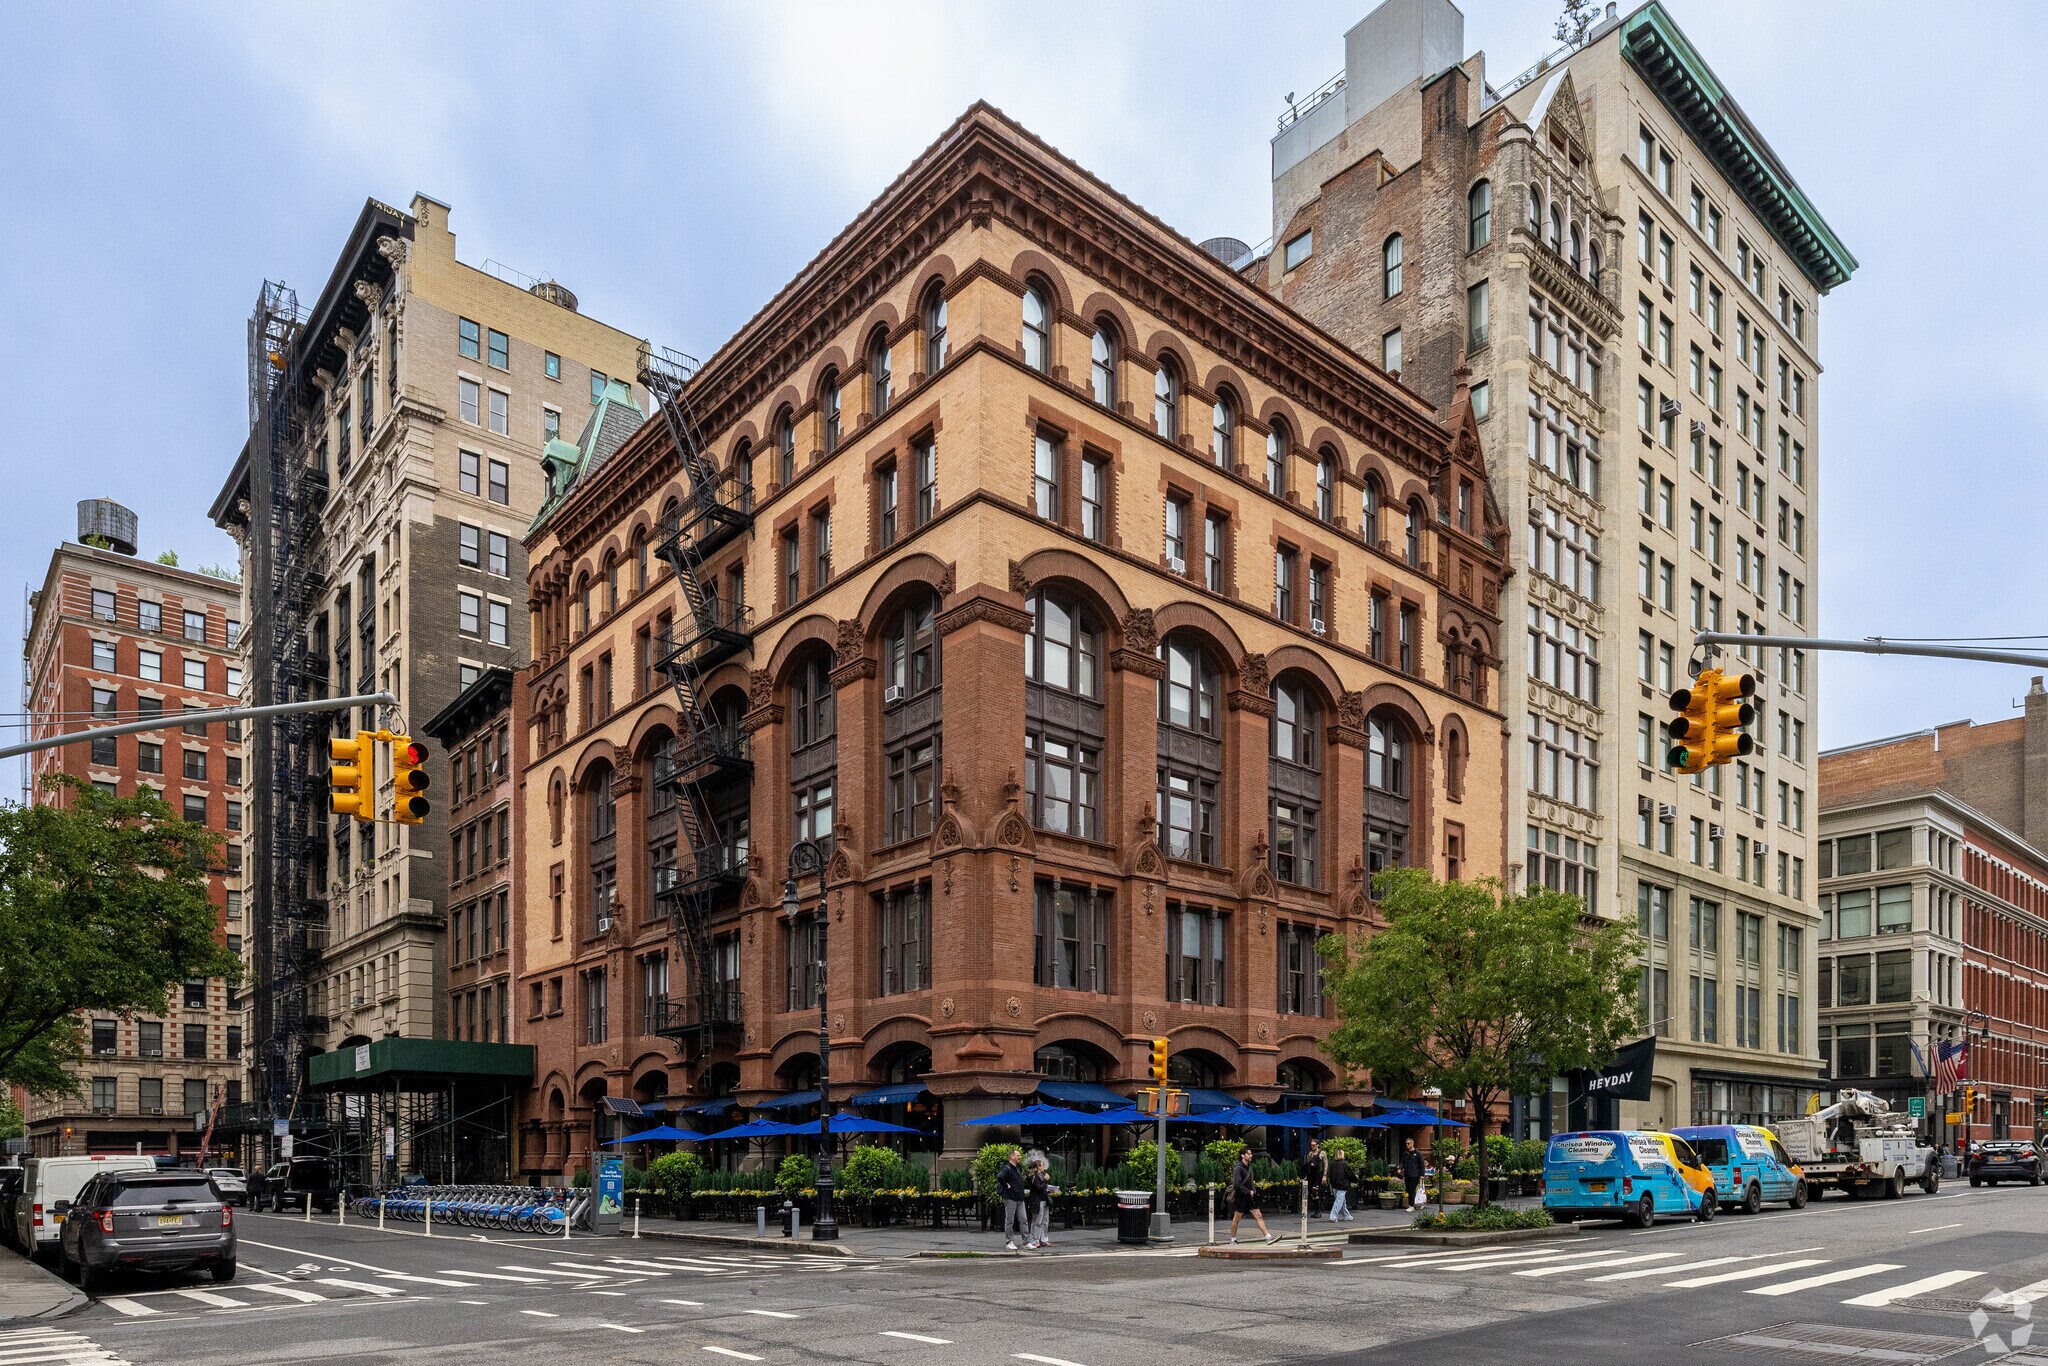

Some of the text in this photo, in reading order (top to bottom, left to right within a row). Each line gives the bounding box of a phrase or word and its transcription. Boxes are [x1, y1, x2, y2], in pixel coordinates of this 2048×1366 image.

[1589, 1072, 1633, 1091] HEYDAY
[1629, 1137, 1664, 1145] Chelsea Window
[1746, 1138, 1762, 1146] Cleaning
[1639, 1145, 1660, 1155] Cleaning
